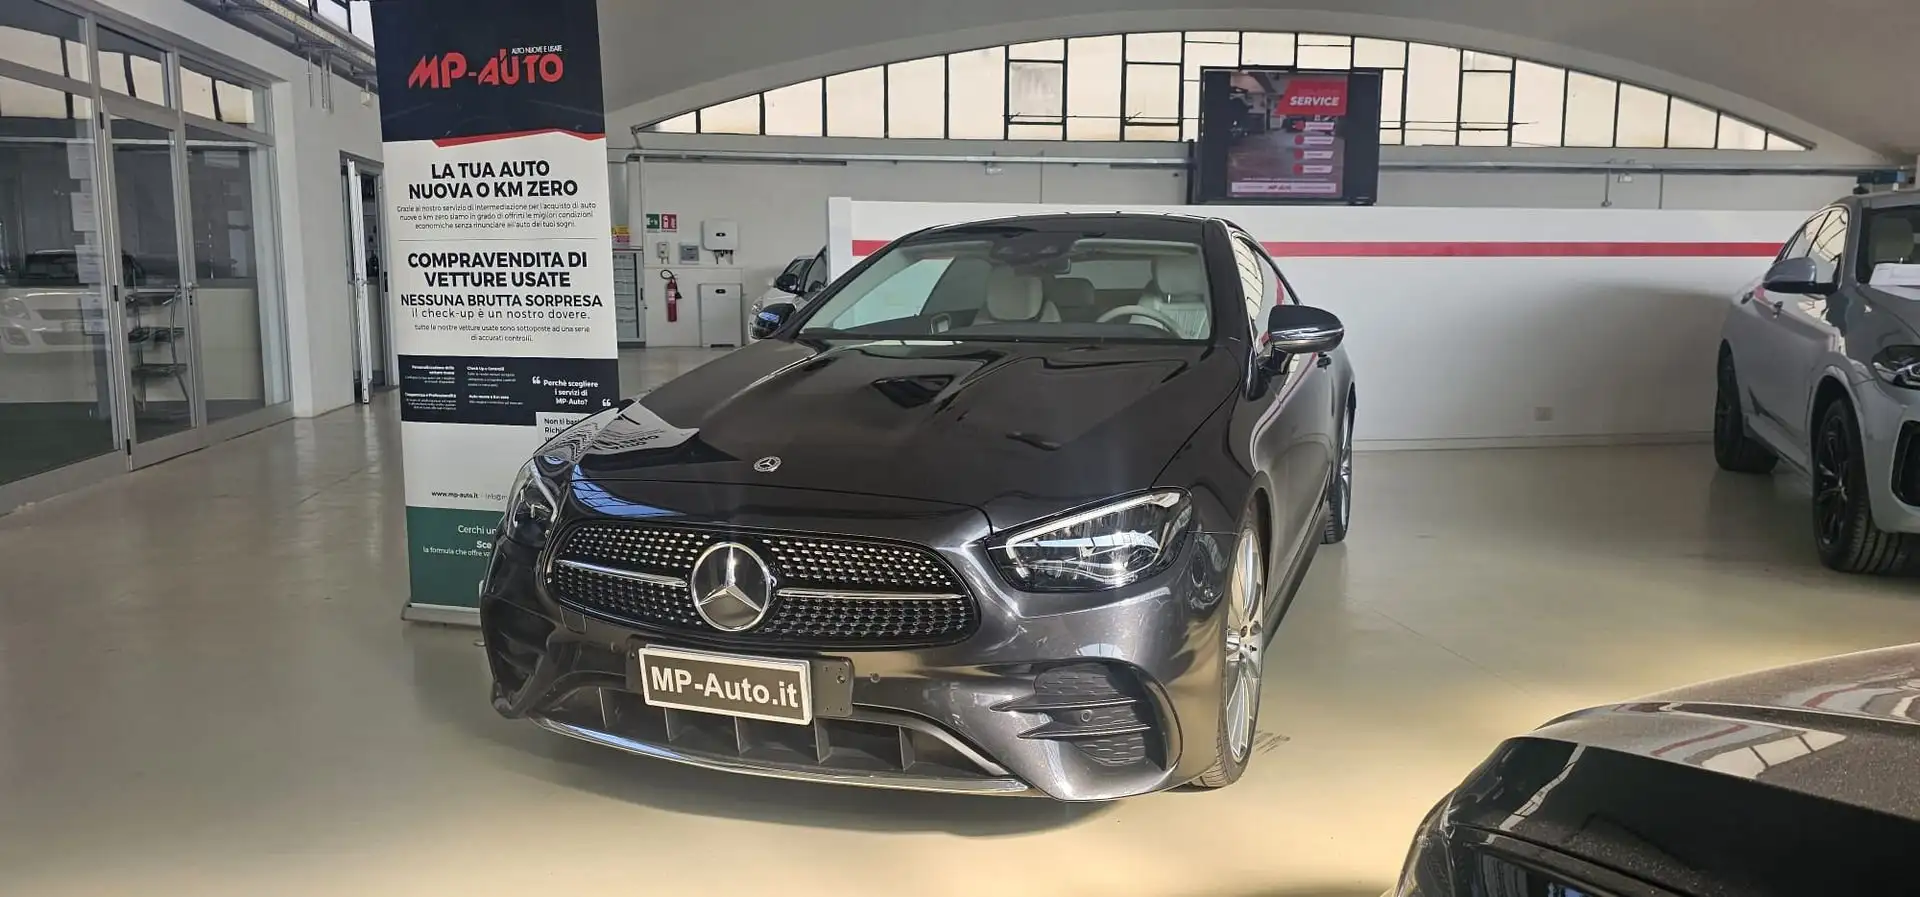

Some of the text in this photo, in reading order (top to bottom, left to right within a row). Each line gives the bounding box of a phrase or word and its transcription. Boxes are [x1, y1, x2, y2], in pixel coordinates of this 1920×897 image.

[408, 48, 563, 88] MP-AUTO
[1290, 96, 1340, 106] SERVICE
[432, 160, 549, 179] LA TUA AUTO
[409, 180, 578, 199] NUOVA O KM ZERO
[475, 203, 527, 211] intermediazione
[477, 213, 495, 221] grado
[534, 211, 557, 219] migliori
[408, 252, 587, 268] COMPRAVENDITA DI
[424, 272, 571, 287] VETTURE USATE
[401, 294, 603, 307] NESSUNA BRUTTA SORPRESA
[412, 308, 590, 320] il check-up è un nostro dovere.
[568, 380, 598, 388] scegliere
[556, 398, 588, 406] MP-Auto?
[432, 491, 478, 499] www.mp-auto.it
[458, 525, 484, 534] Cerchi
[430, 546, 454, 555] formula
[651, 666, 799, 708] MP-Auto.it
